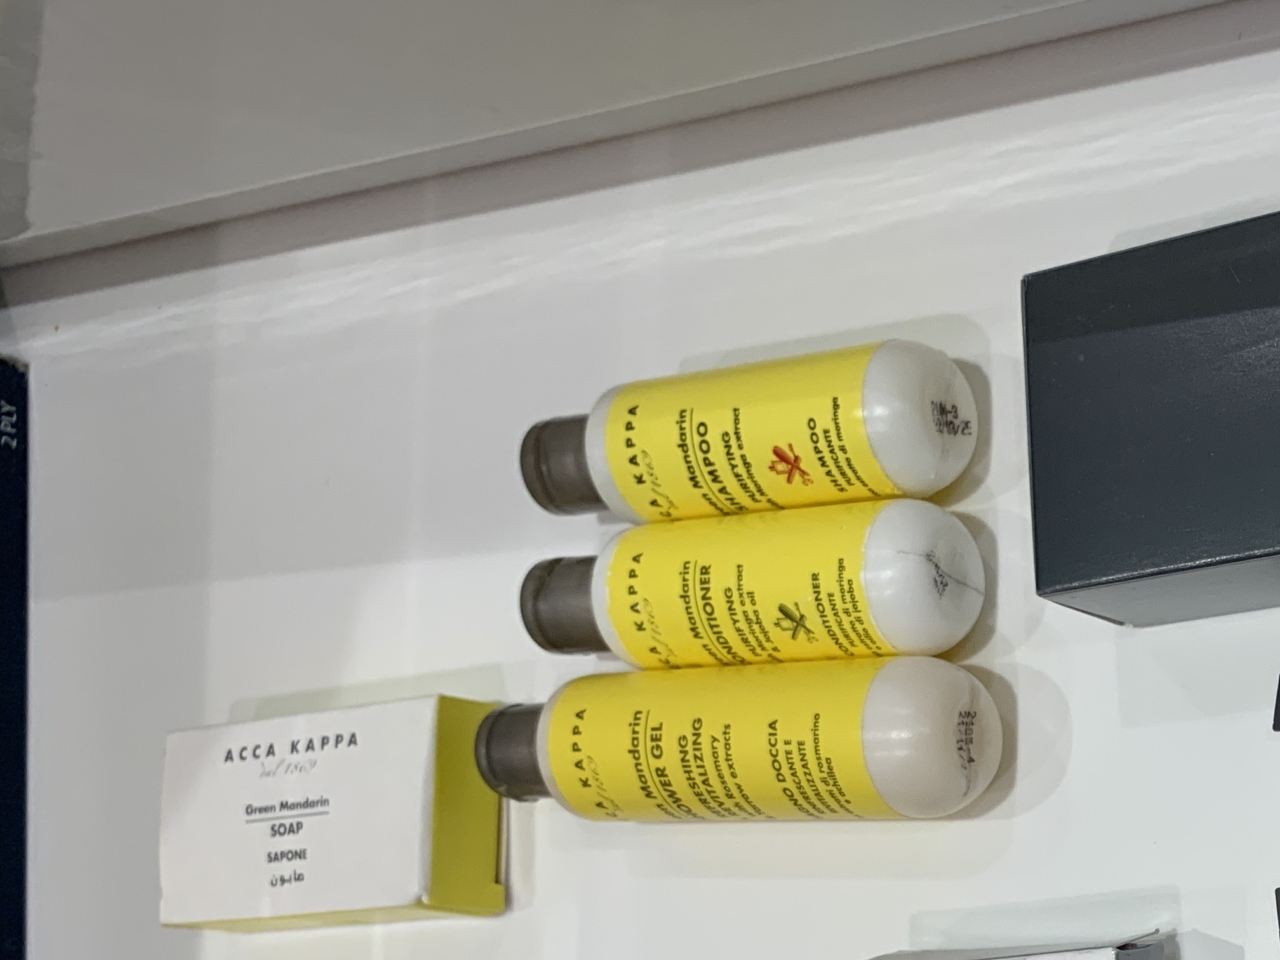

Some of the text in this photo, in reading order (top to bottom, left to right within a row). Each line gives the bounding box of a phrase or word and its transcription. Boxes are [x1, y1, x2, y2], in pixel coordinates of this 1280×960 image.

[625, 404, 646, 485] KAPPA
[733, 407, 744, 451] extract
[831, 396, 844, 442] moringa
[676, 408, 703, 490] Mandarin
[722, 430, 762, 503] PURIFYING
[807, 417, 848, 493] SHAMPOO
[823, 428, 855, 487] PURIFICANTE
[838, 444, 848, 455] di
[628, 552, 647, 632] KAPPA
[679, 560, 704, 640] Mandarin
[736, 564, 747, 607] extract
[746, 591, 757, 607] oil
[836, 558, 846, 605] moringa
[846, 579, 862, 614] jojoba
[699, 564, 750, 666] ONDITIONER
[723, 586, 763, 657] PURIFYING
[827, 592, 859, 648] PURIFICANTE
[841, 607, 852, 618] di
[224, 732, 358, 763] ACCA KAPPA
[572, 708, 592, 788] KAPPA
[628, 709, 658, 800] Mandarin
[650, 722, 698, 817] OWER GEL
[711, 735, 736, 799] Rosemary
[722, 723, 738, 779] extracts
[768, 719, 787, 783] DOCCIA
[811, 712, 825, 774] rosmarino
[245, 796, 330, 816] Green Mandarin
[820, 776, 831, 787] di
[267, 848, 308, 864] SAPONE
[270, 821, 304, 838] SOAP
